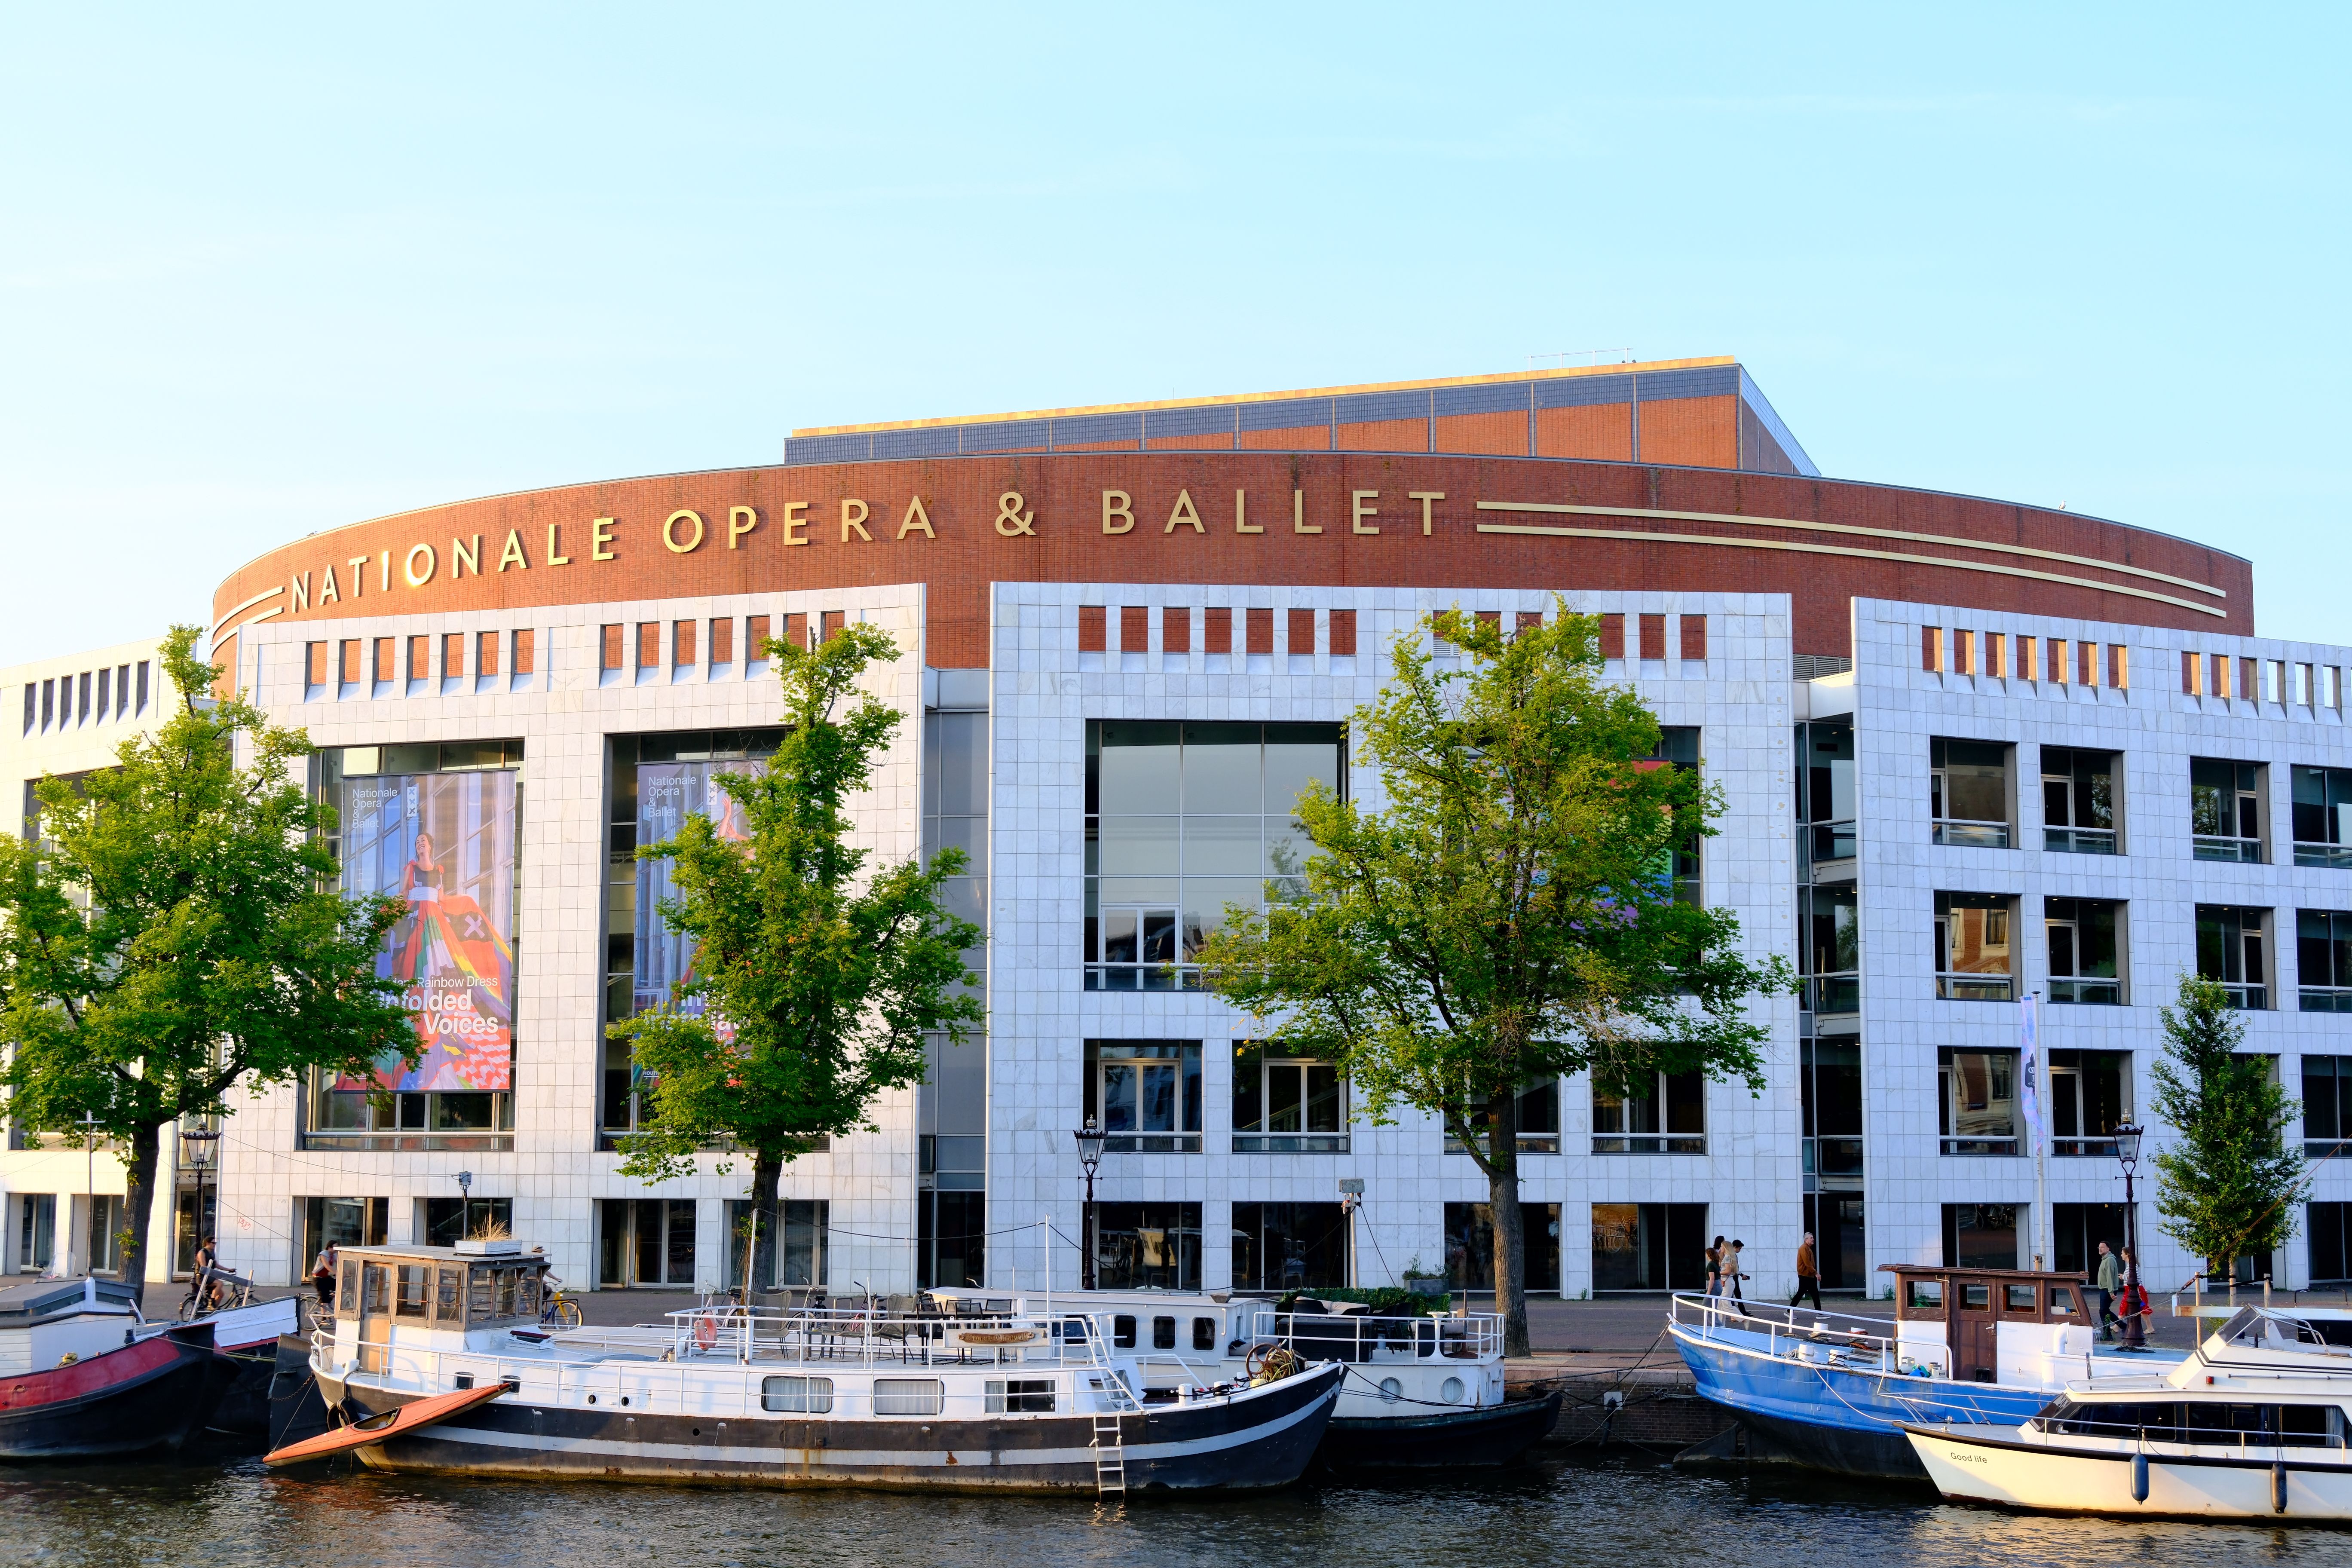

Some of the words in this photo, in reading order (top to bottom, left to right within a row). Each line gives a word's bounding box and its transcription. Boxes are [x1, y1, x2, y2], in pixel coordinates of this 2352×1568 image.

[292, 517, 614, 613] NATIONALE
[663, 495, 936, 553] OPERA
[995, 491, 1037, 536] &
[1102, 489, 1446, 536] BALLET
[648, 775, 696, 786] Nationale
[352, 787, 398, 798] Nationale
[648, 787, 680, 798] Opera
[352, 799, 382, 810] Opera
[648, 797, 656, 807] &
[352, 809, 360, 819] &
[648, 807, 677, 818] Ballet
[352, 819, 379, 829] Ballet
[418, 977, 464, 988] Rainbow
[467, 975, 498, 986] Dress
[424, 1012, 499, 1035] Voices
[1951, 1452, 1972, 1461] Good
[1974, 1455, 1988, 1463] life
